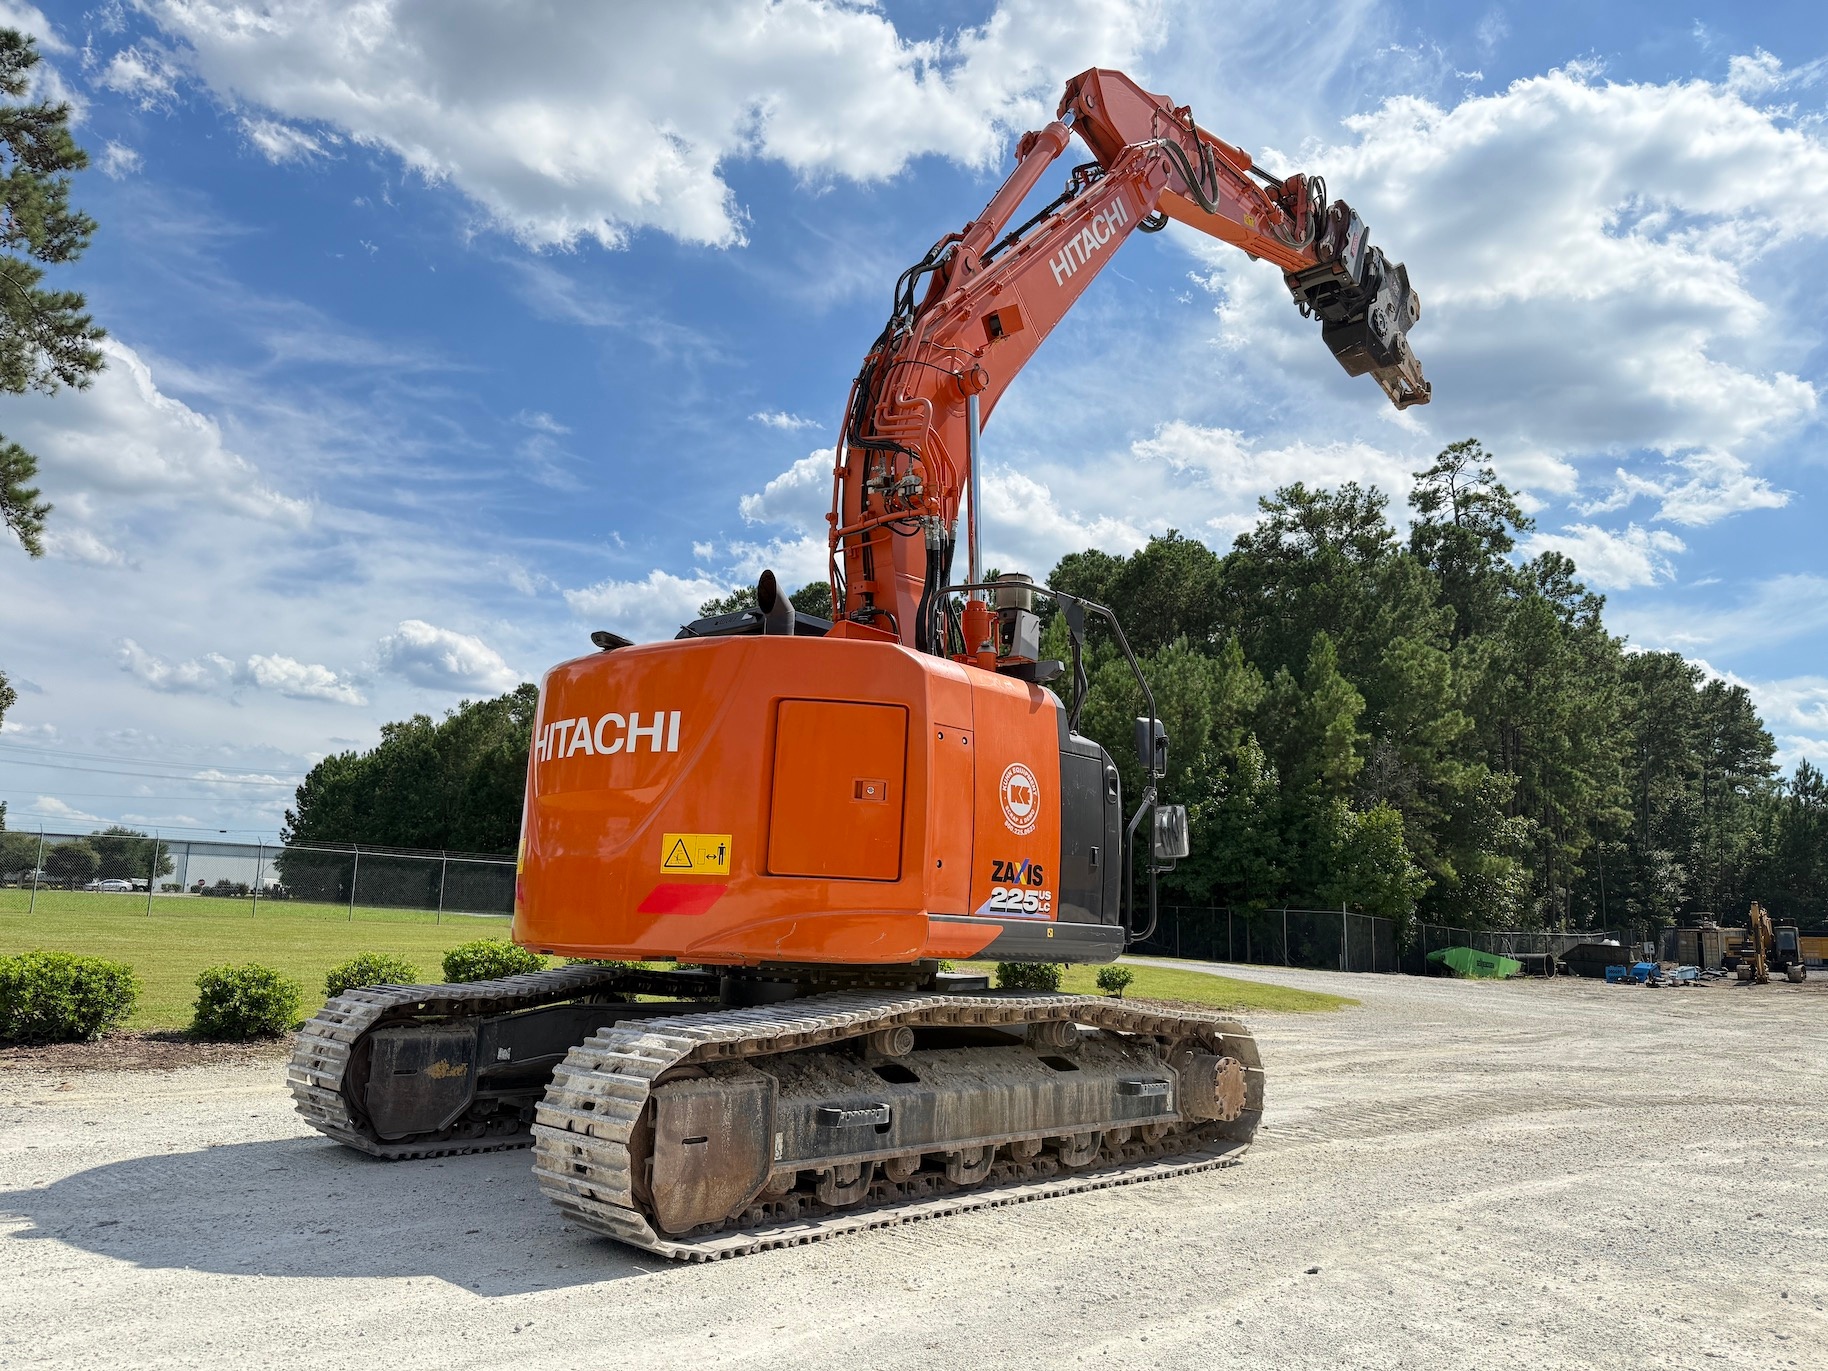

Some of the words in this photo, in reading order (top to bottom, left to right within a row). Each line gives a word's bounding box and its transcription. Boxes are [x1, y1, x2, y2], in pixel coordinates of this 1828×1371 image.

[1049, 196, 1128, 287] HITACHI
[535, 710, 681, 762] HITACHI
[1002, 769, 1013, 791] KUHN
[1012, 767, 1038, 796] EQUIPMENT
[1005, 805, 1019, 823] SCRAP
[991, 858, 1043, 886] ZAXIS
[990, 887, 1039, 914] 225
[1039, 891, 1052, 901] US
[1038, 902, 1051, 912] LC
